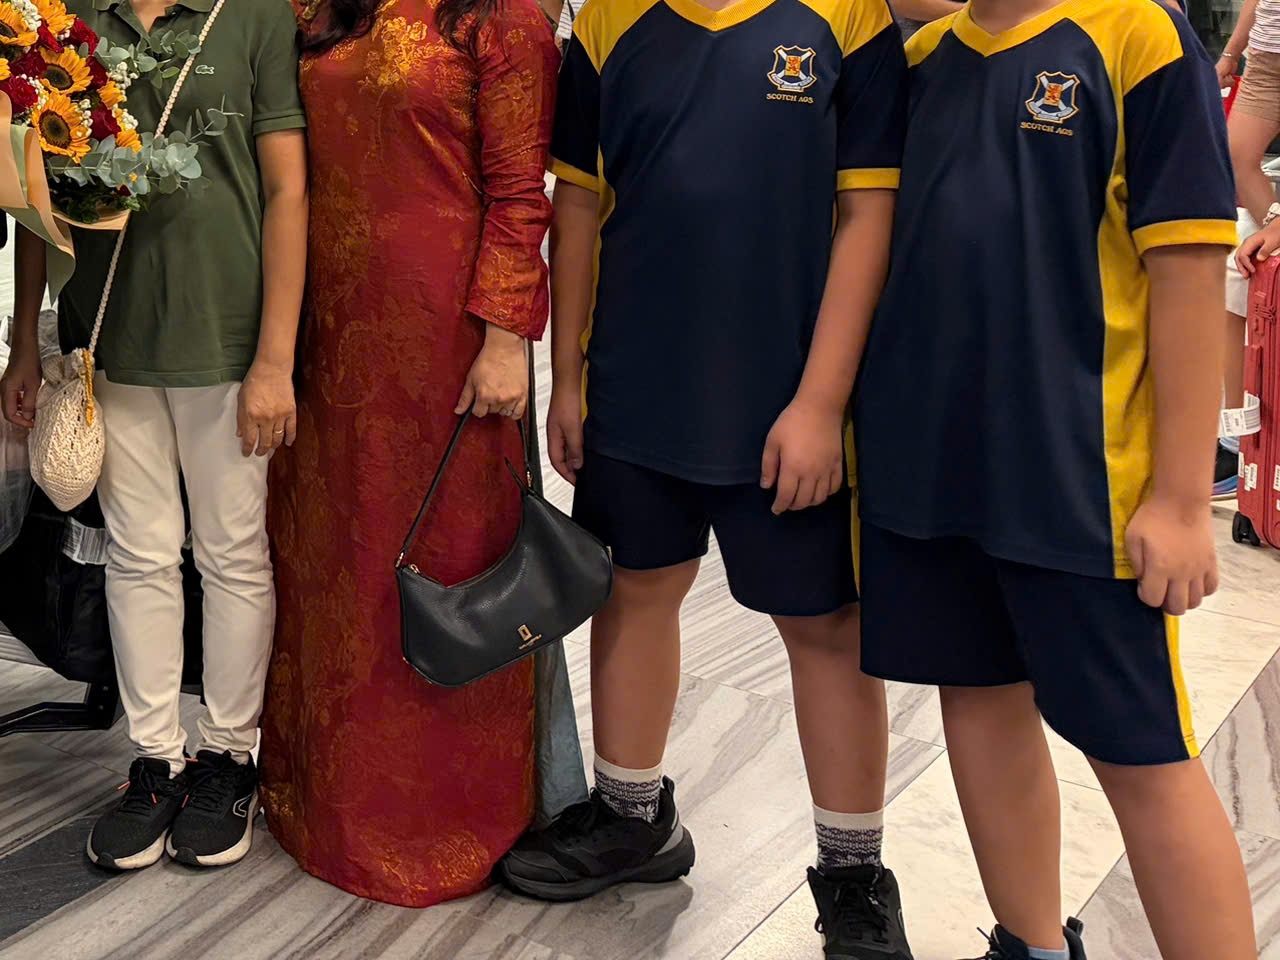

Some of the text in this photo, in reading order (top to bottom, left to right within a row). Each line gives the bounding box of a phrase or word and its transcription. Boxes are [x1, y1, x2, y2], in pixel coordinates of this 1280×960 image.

[766, 92, 815, 105] SCOTCH AGS
[1020, 121, 1054, 134] SCOTCH
